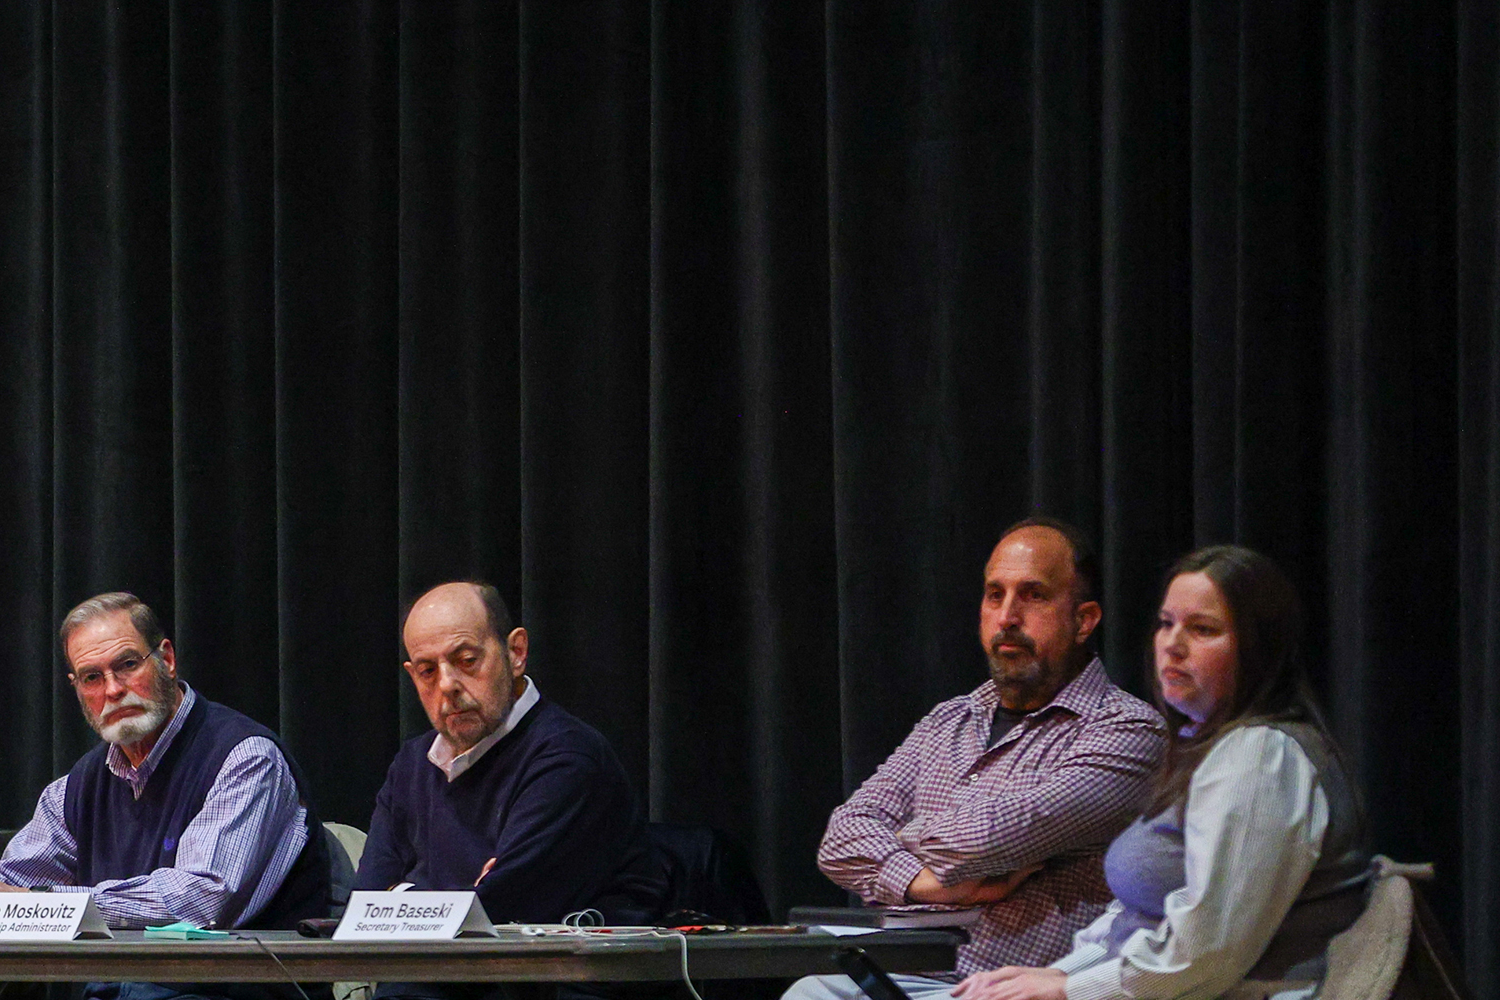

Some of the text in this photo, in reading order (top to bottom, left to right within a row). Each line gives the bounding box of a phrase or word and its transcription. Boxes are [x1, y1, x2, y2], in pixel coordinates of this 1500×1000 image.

[3, 903, 76, 919] Moskovitz
[363, 903, 454, 919] Tom Baseski
[8, 922, 72, 932] Administrator
[354, 922, 444, 934] Secretary Treasurer
